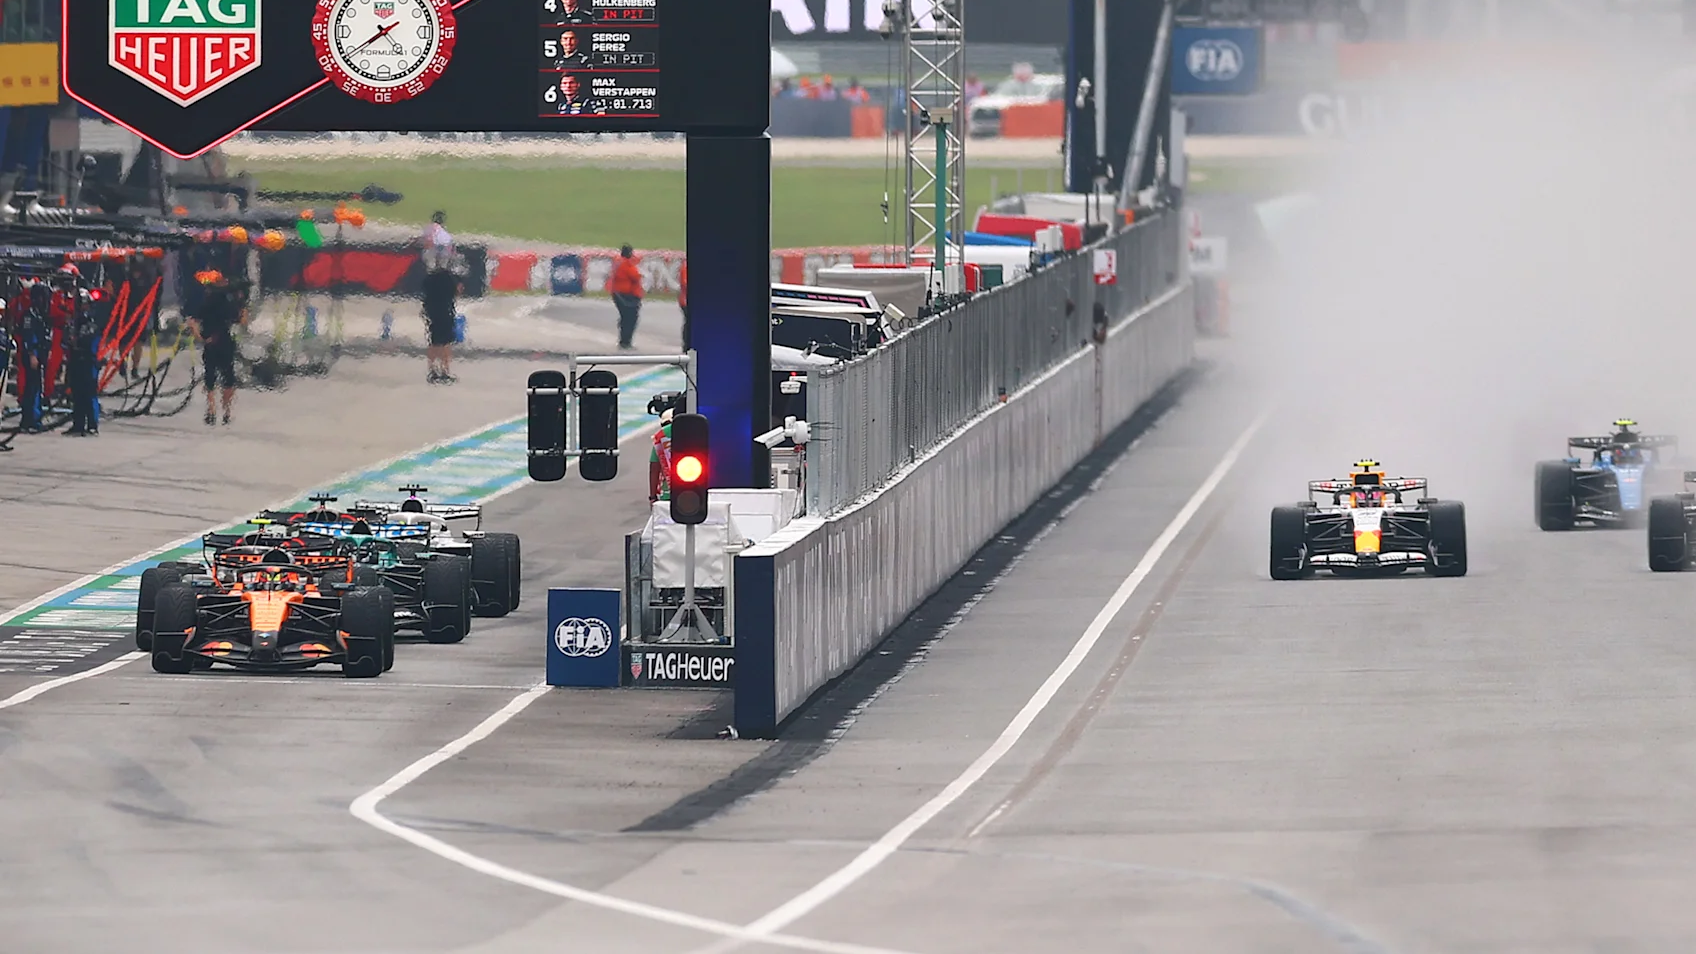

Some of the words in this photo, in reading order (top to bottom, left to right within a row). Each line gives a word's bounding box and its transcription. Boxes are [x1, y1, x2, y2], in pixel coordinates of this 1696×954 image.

[603, 9, 618, 19] IN
[623, 9, 645, 19] PIT
[313, 23, 323, 41] 45
[445, 26, 455, 39] 15
[592, 33, 630, 42] SERGIO
[544, 40, 557, 57] 5
[592, 43, 626, 52] PEREZ
[318, 56, 333, 73] 40
[602, 54, 617, 64] IN
[623, 54, 644, 64] PIT
[119, 36, 251, 95] HEUER
[432, 57, 448, 74] 20
[592, 78, 616, 87] MAX
[374, 92, 392, 103] 30
[544, 85, 557, 103] 6
[592, 88, 656, 96] VERSTAPPEN
